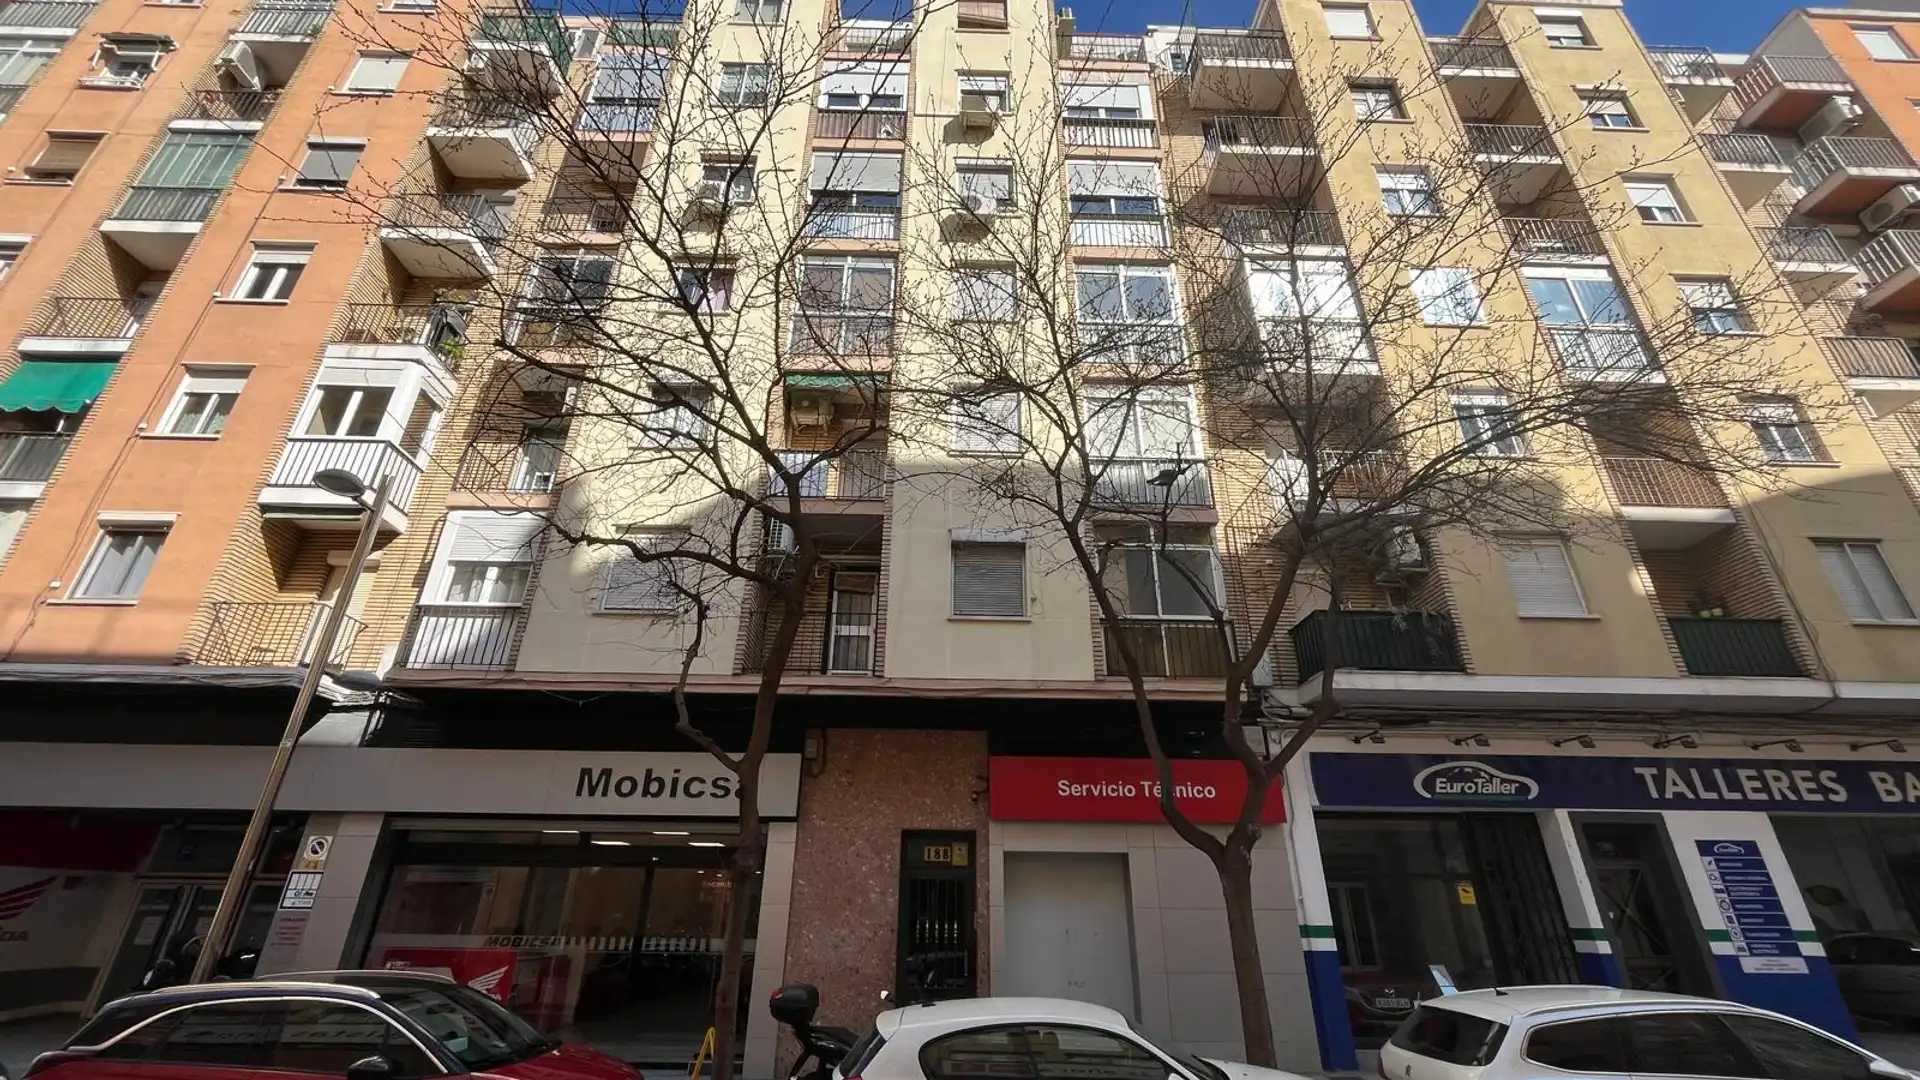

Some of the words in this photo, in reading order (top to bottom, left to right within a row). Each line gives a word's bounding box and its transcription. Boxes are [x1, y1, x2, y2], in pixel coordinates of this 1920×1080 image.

[1058, 779, 1136, 797] Servicio
[1140, 781, 1217, 799] Ténico
[1435, 777, 1519, 794] EuroTaller
[1633, 767, 1848, 803] TALLERES
